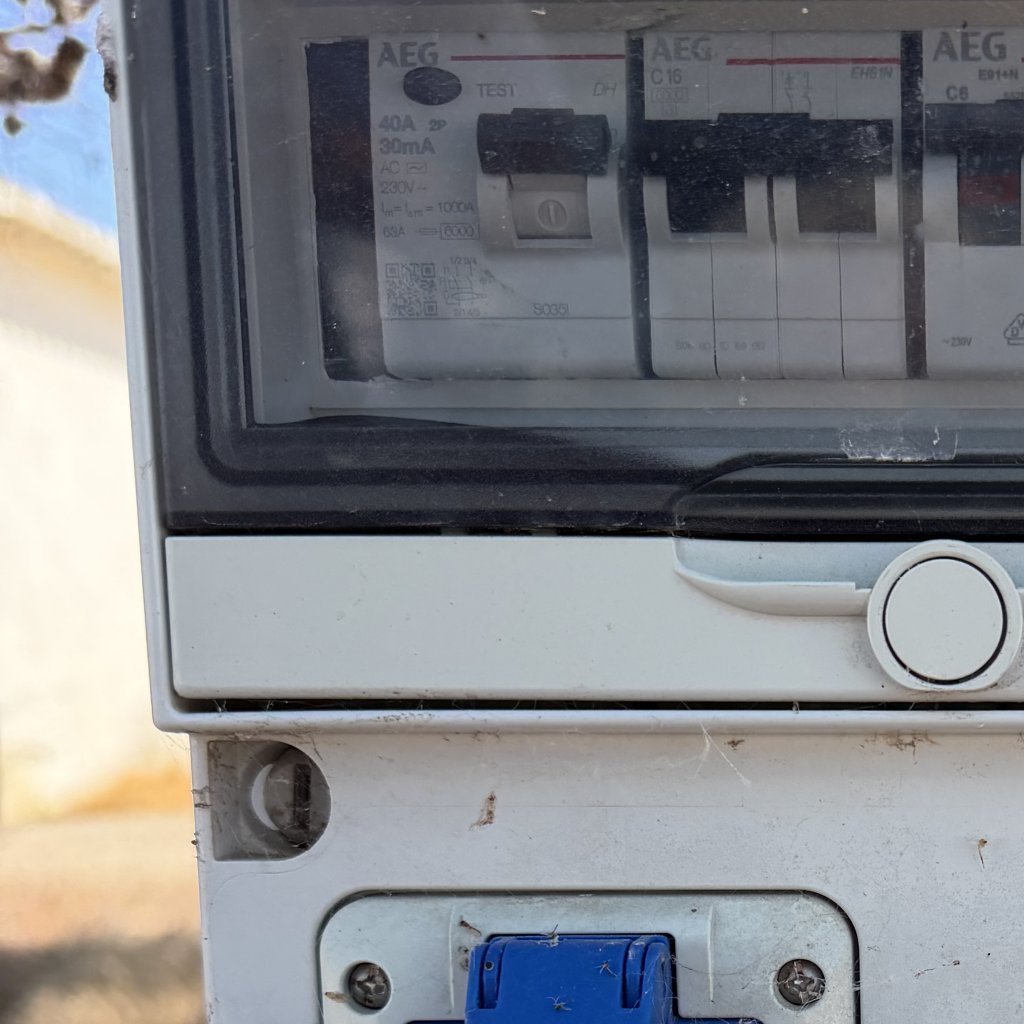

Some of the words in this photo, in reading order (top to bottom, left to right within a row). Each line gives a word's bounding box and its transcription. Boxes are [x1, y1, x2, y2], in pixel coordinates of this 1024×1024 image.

[378, 42, 438, 67] AEG
[652, 36, 712, 62] AEG
[933, 31, 1007, 62] AEG
[477, 82, 517, 97] TEST
[946, 85, 969, 100] C6
[378, 115, 416, 132] 40A
[429, 119, 447, 131] 2P
[379, 137, 436, 155] 30mA
[380, 162, 400, 174] AC
